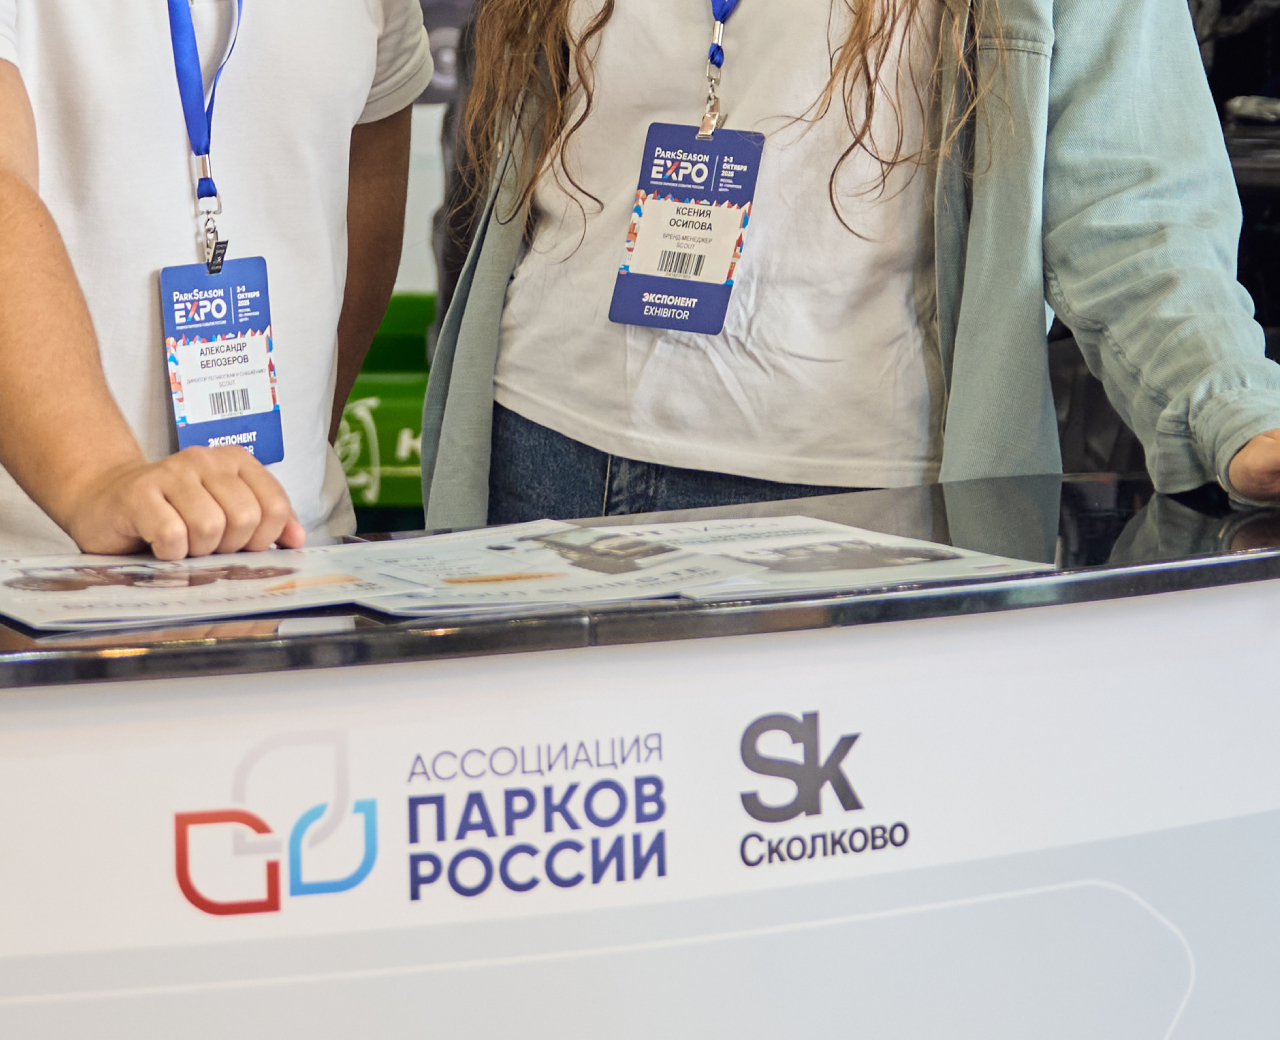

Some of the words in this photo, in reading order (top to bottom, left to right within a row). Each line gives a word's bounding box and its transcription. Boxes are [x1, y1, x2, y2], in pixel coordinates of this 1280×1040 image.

[651, 159, 708, 183] EXPO
[676, 207, 712, 218] КСЕНИЯ
[669, 218, 712, 231] ОСИПОВА
[642, 292, 698, 308] ЭКСПОНЕНТ
[174, 298, 227, 324] EXPO
[643, 305, 690, 320] EXHIBITOR
[200, 343, 247, 356] АЛЕКСАНДР
[200, 355, 249, 369] БЕЛОЗЕРОВ
[208, 431, 257, 448] ЭКСПОНЕНТ
[407, 733, 664, 783] АССОЦИАЦИЯ
[739, 710, 863, 823] Sk
[407, 775, 667, 844] ПАРКОВ
[408, 829, 668, 901] РОССИИ
